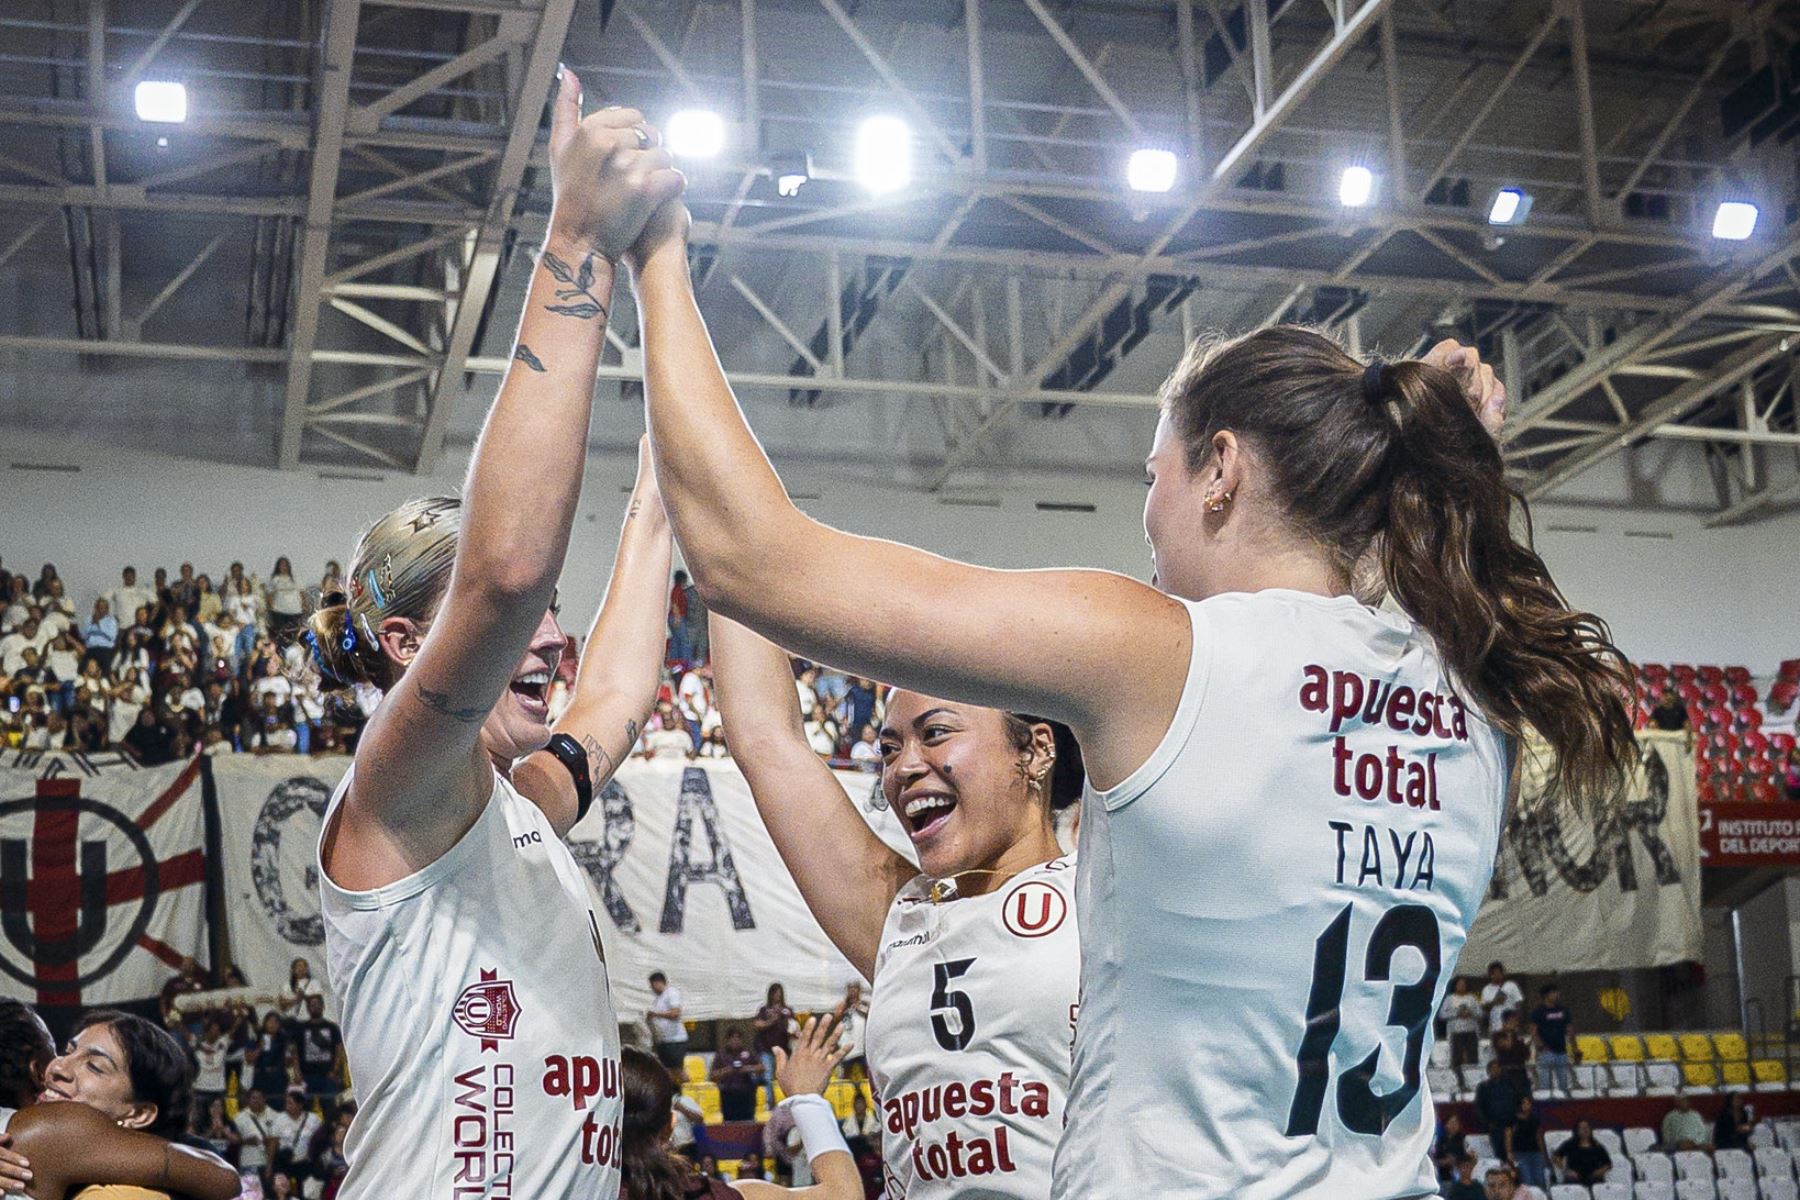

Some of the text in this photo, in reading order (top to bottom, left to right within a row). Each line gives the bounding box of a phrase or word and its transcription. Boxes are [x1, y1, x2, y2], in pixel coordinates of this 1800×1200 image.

[1299, 664, 1468, 742] apuesta
[1332, 735, 1441, 811] total
[1328, 820, 1434, 891] TAYA
[1718, 820, 1793, 835] INSTITUTO
[1720, 838, 1746, 853] DEL
[1017, 892, 1052, 930] U
[466, 1002, 488, 1018] U
[930, 957, 978, 1051] 5
[1285, 901, 1441, 1136] 13
[883, 1072, 1050, 1140] apuesta
[912, 1125, 1016, 1182] total
